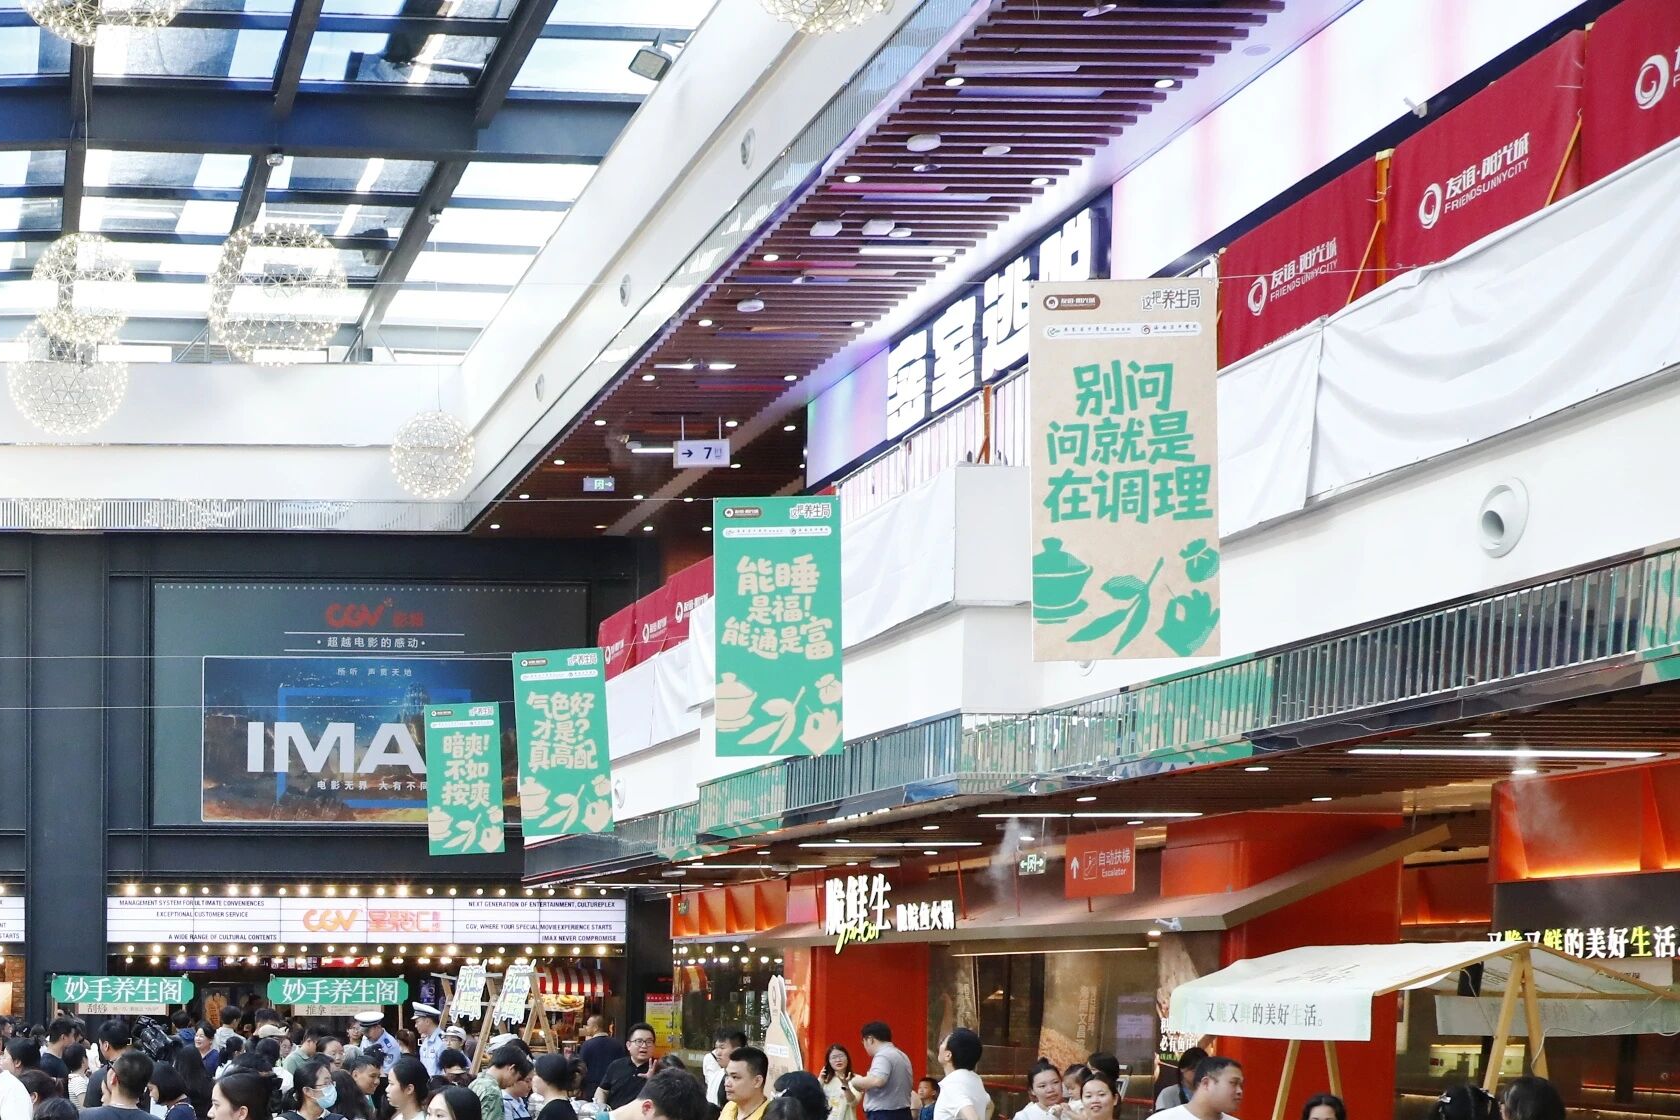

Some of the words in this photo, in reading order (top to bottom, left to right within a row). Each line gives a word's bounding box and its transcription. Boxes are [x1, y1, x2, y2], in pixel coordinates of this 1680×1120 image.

[1443, 157, 1529, 214] FRIENDSUNNYCITY
[1142, 289, 1200, 310] 这把养生局
[1073, 360, 1175, 416] 别问
[1046, 410, 1195, 466] 问就是
[704, 447, 712, 459] 7
[1043, 464, 1213, 524] 在调理
[736, 553, 820, 597] 能睡
[325, 602, 387, 628] CGV
[327, 636, 419, 649] 超越电影的感动
[721, 616, 834, 661] 能通是富
[526, 691, 595, 721] 气色好
[532, 719, 590, 742] 才是?
[247, 721, 428, 774] IMA
[442, 732, 490, 760] 暗爽!
[528, 739, 598, 773] 真高配
[444, 759, 489, 780] 不如
[317, 781, 368, 790] 电影无界
[441, 780, 491, 810] 按爽
[1098, 848, 1130, 866] 自动扶梯
[1101, 868, 1127, 878] Escalator
[303, 908, 357, 932] CGV
[64, 977, 182, 1002] 妙手养生阁
[282, 979, 399, 1004] 妙手养生阁
